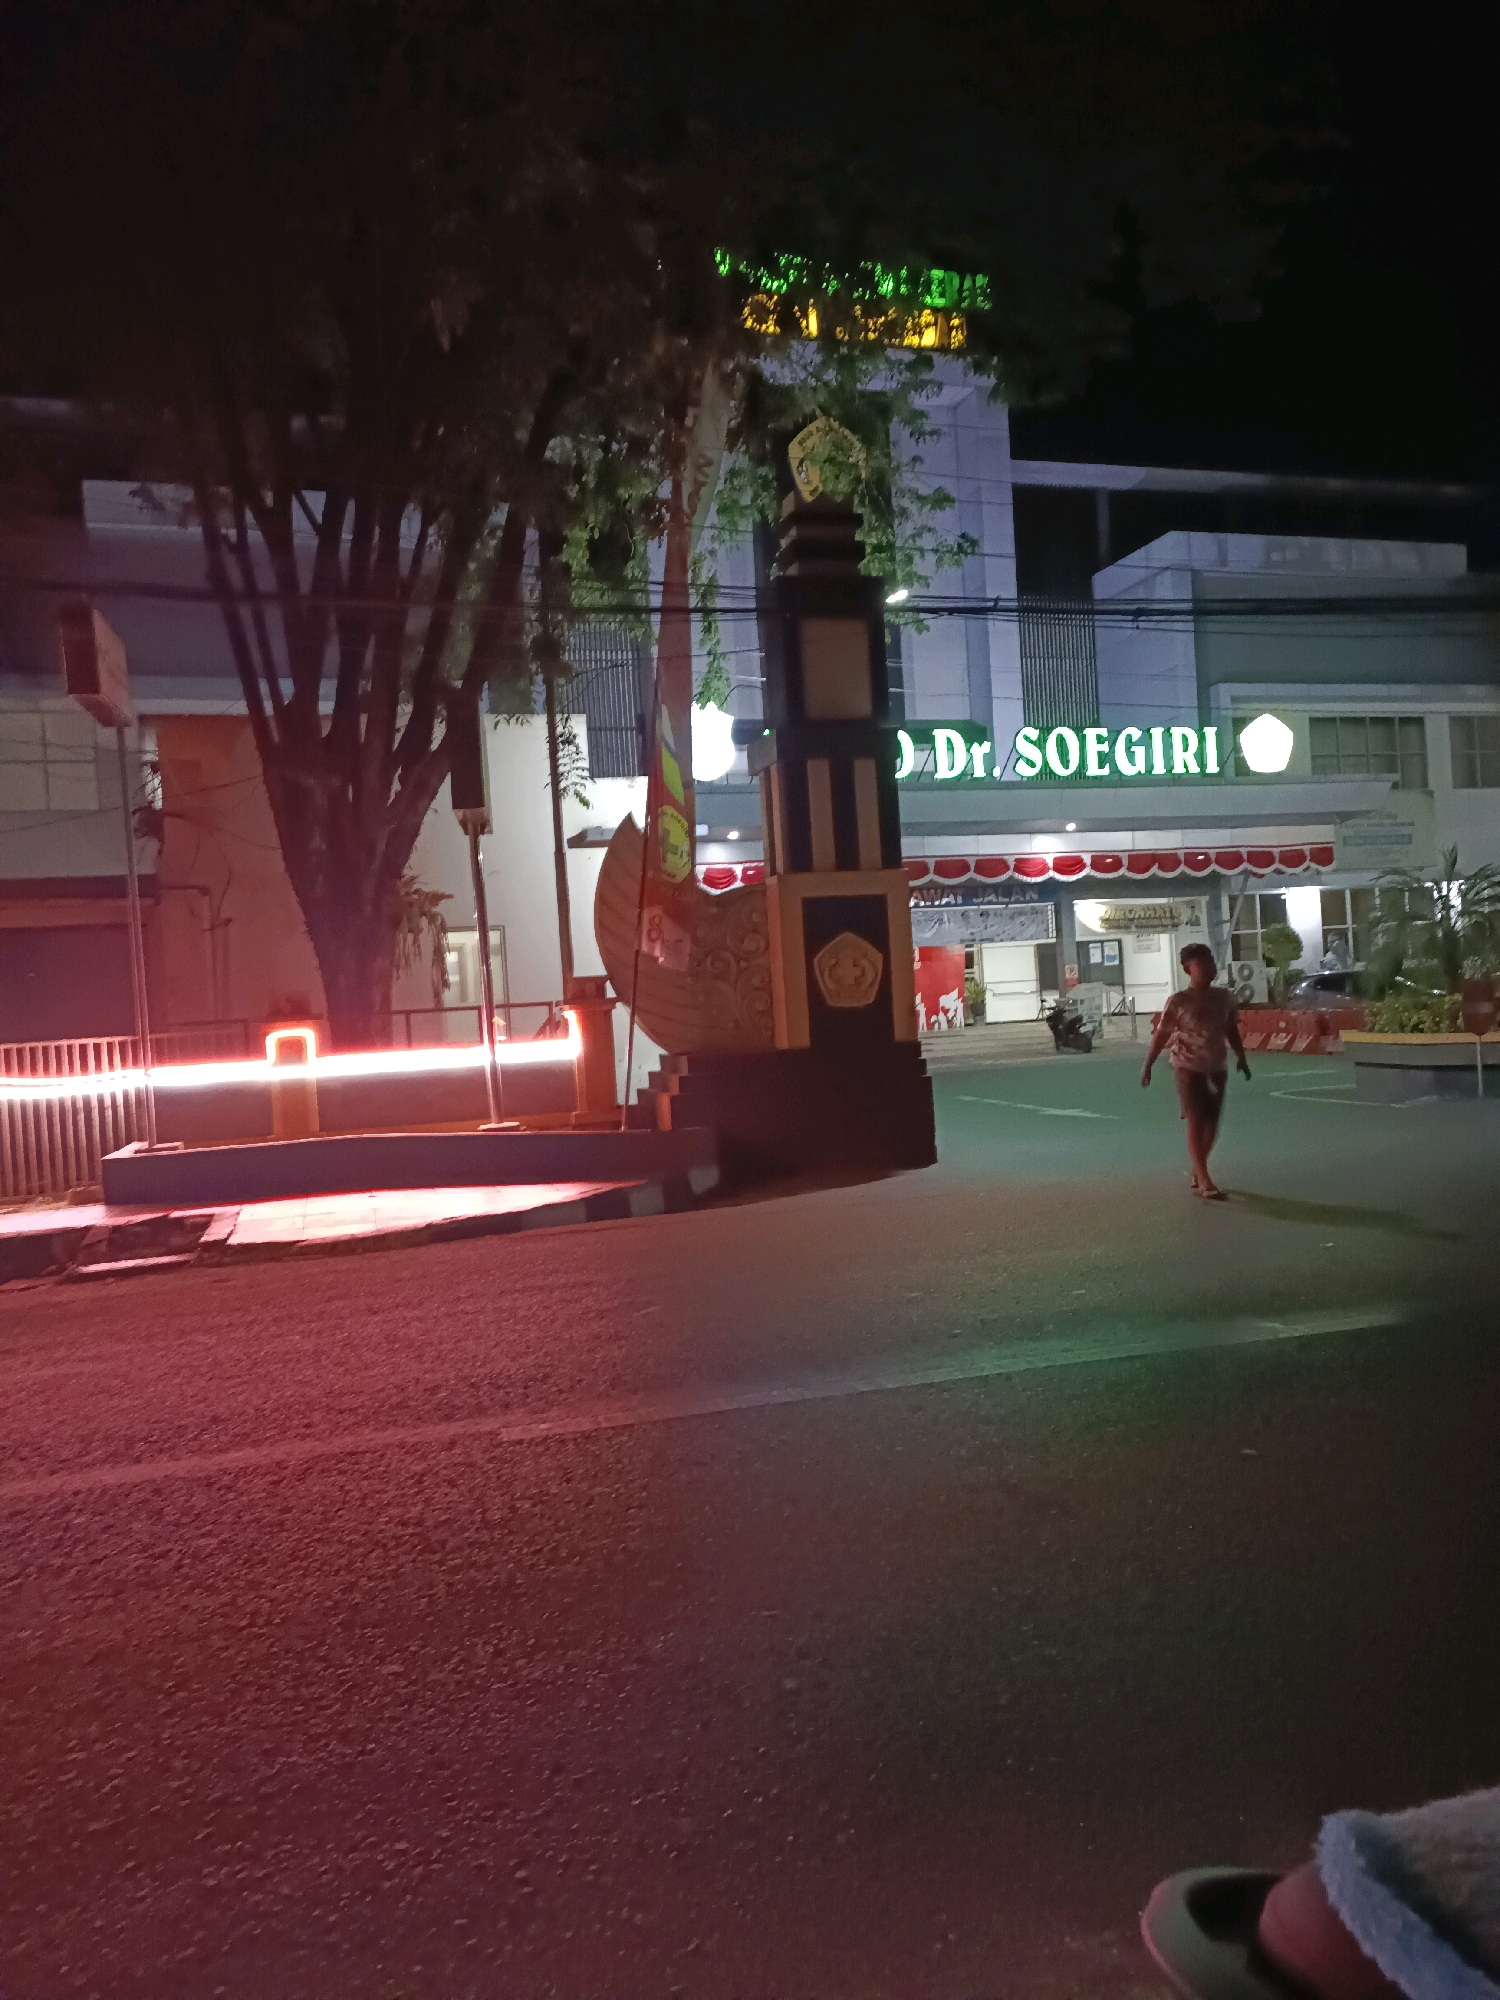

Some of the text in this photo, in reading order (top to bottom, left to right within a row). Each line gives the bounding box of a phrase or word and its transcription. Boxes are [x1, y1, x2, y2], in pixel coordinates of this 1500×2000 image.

[932, 728, 1001, 779] Dr.
[1014, 726, 1220, 777] SOEGIRI
[909, 886, 1038, 907] AWAT JALAN
